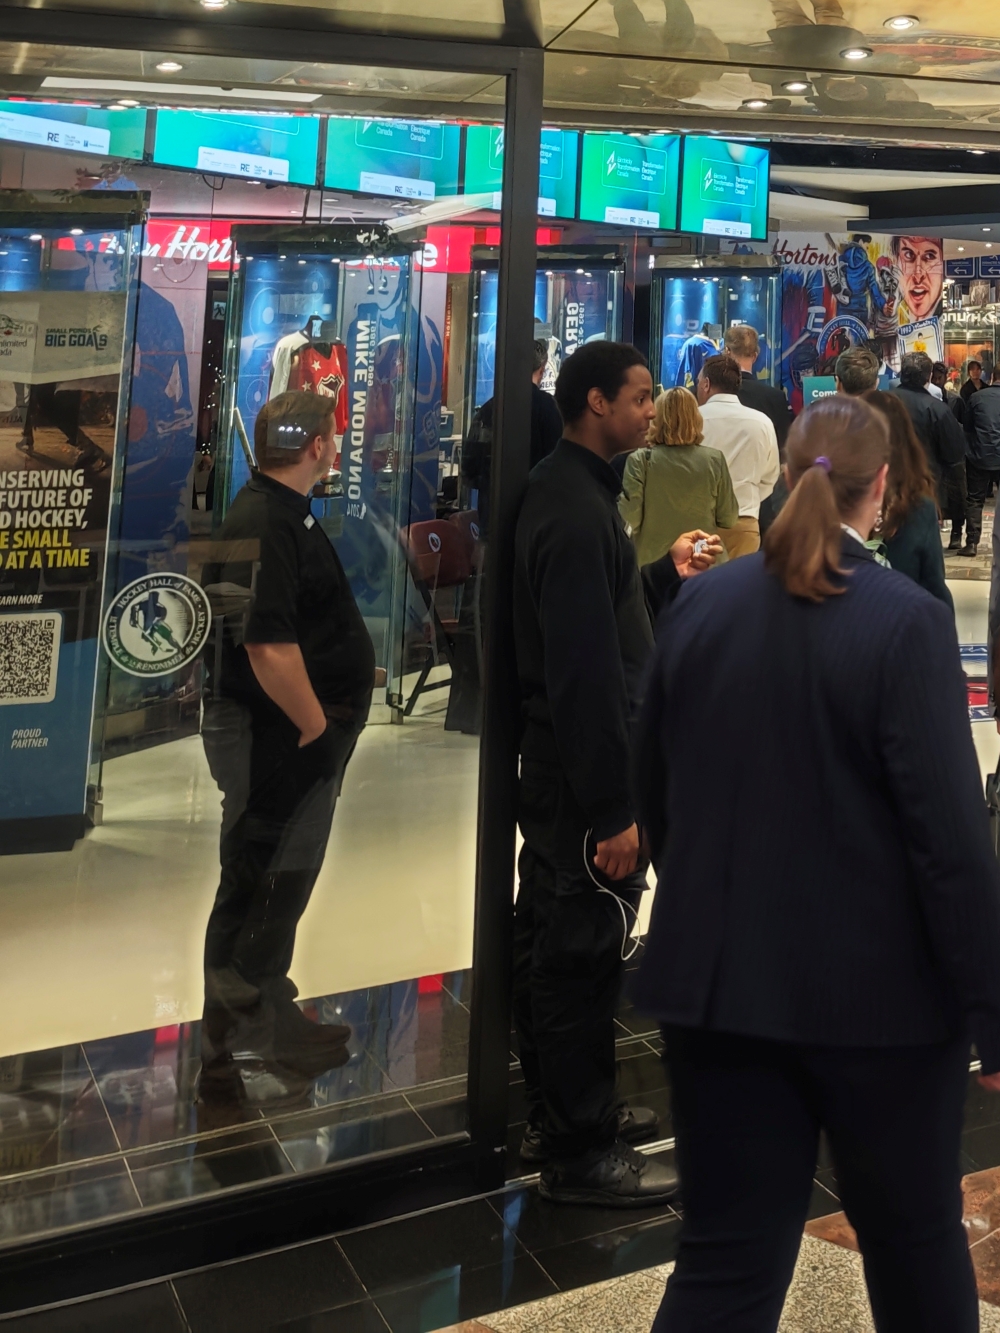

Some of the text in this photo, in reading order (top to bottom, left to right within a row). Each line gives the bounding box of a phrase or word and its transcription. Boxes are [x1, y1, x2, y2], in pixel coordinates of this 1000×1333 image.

[772, 237, 838, 267] Hortons
[45, 332, 108, 350] BIG GOALS
[70, 488, 93, 507] OF
[15, 509, 88, 530] HOCKEY,
[12, 529, 72, 549] SMALL
[5, 548, 91, 570] AT A TIME
[18, 594, 43, 605] MORE
[117, 581, 148, 609] HOCKEY
[150, 578, 173, 587] HALL
[182, 583, 201, 604] FAME
[191, 611, 206, 645] HOCKEY
[11, 737, 48, 749] PARTNER
[12, 728, 41, 739] PROUD
